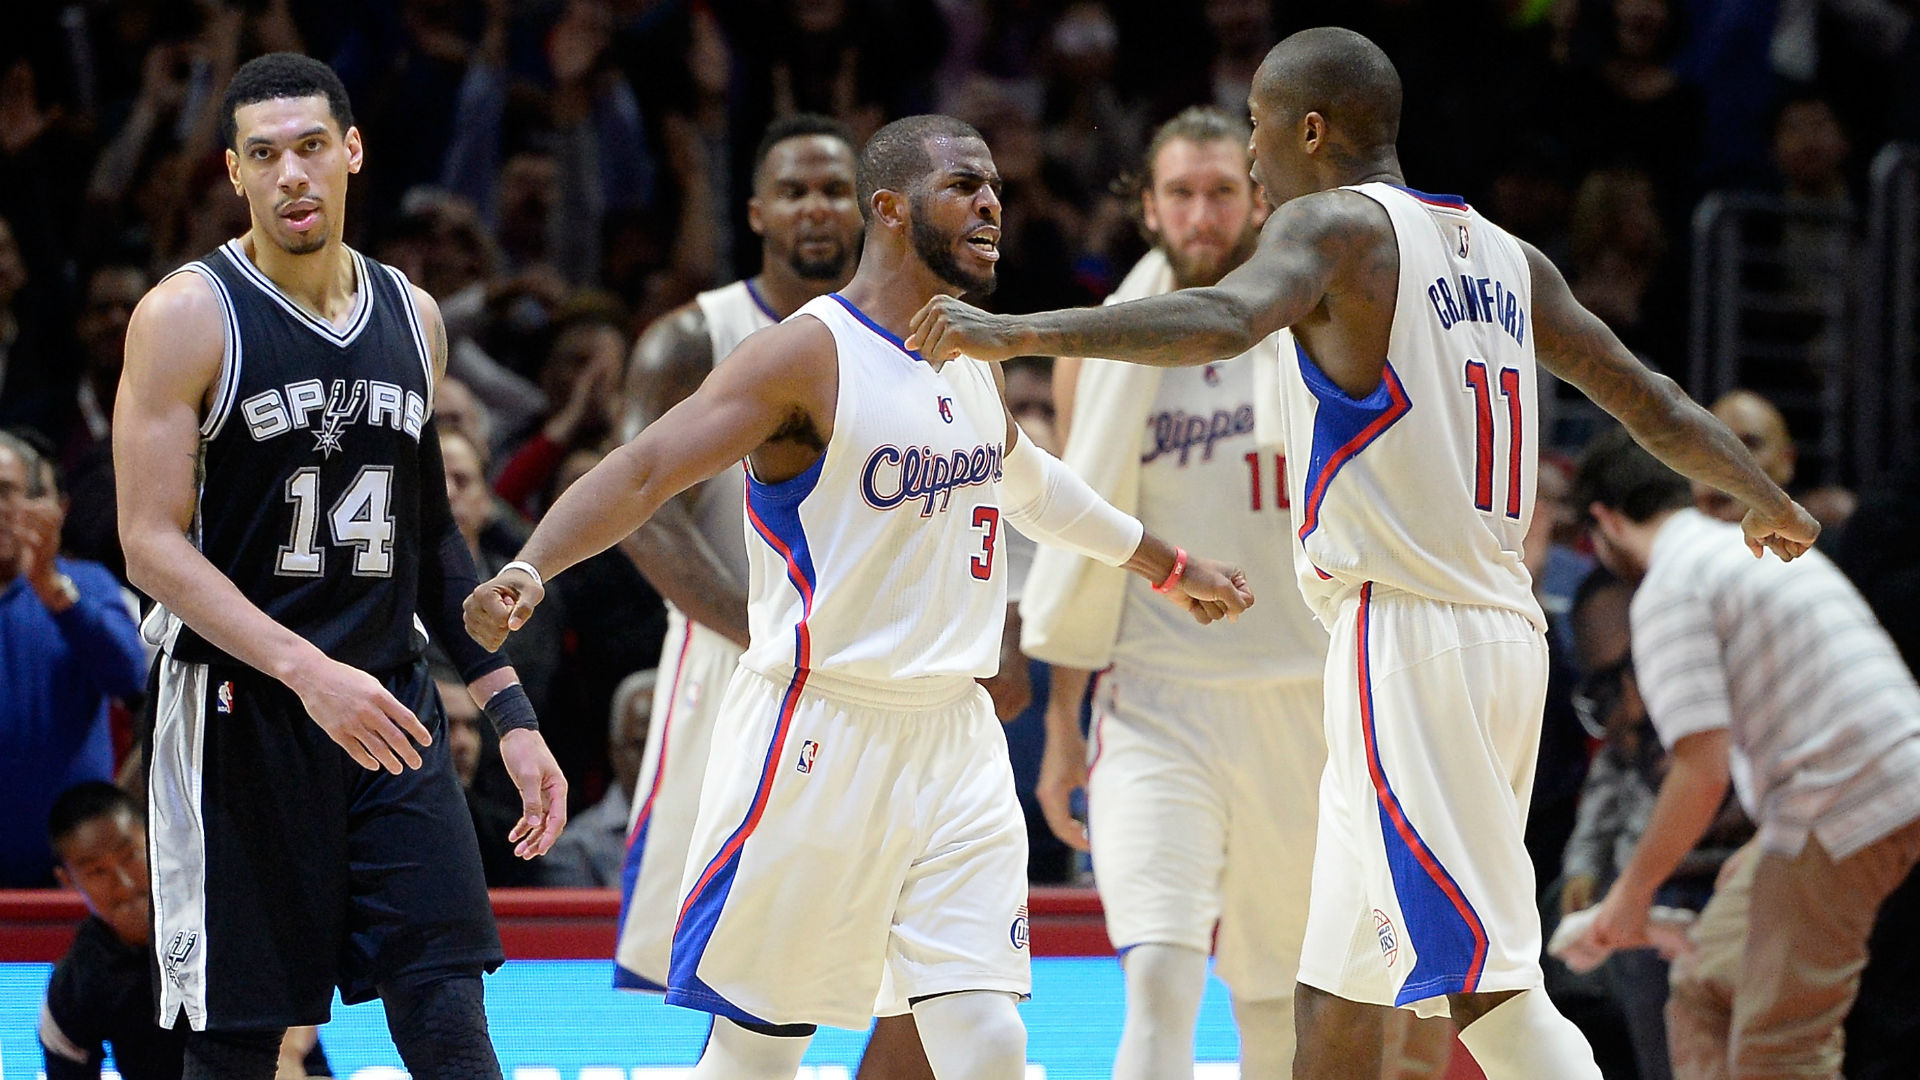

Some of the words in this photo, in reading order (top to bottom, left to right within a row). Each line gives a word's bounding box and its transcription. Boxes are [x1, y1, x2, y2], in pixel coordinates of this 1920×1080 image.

[240, 378, 425, 456] SPURS
[1464, 358, 1523, 521] 11
[274, 464, 396, 578] 14
[970, 505, 999, 581] 3
